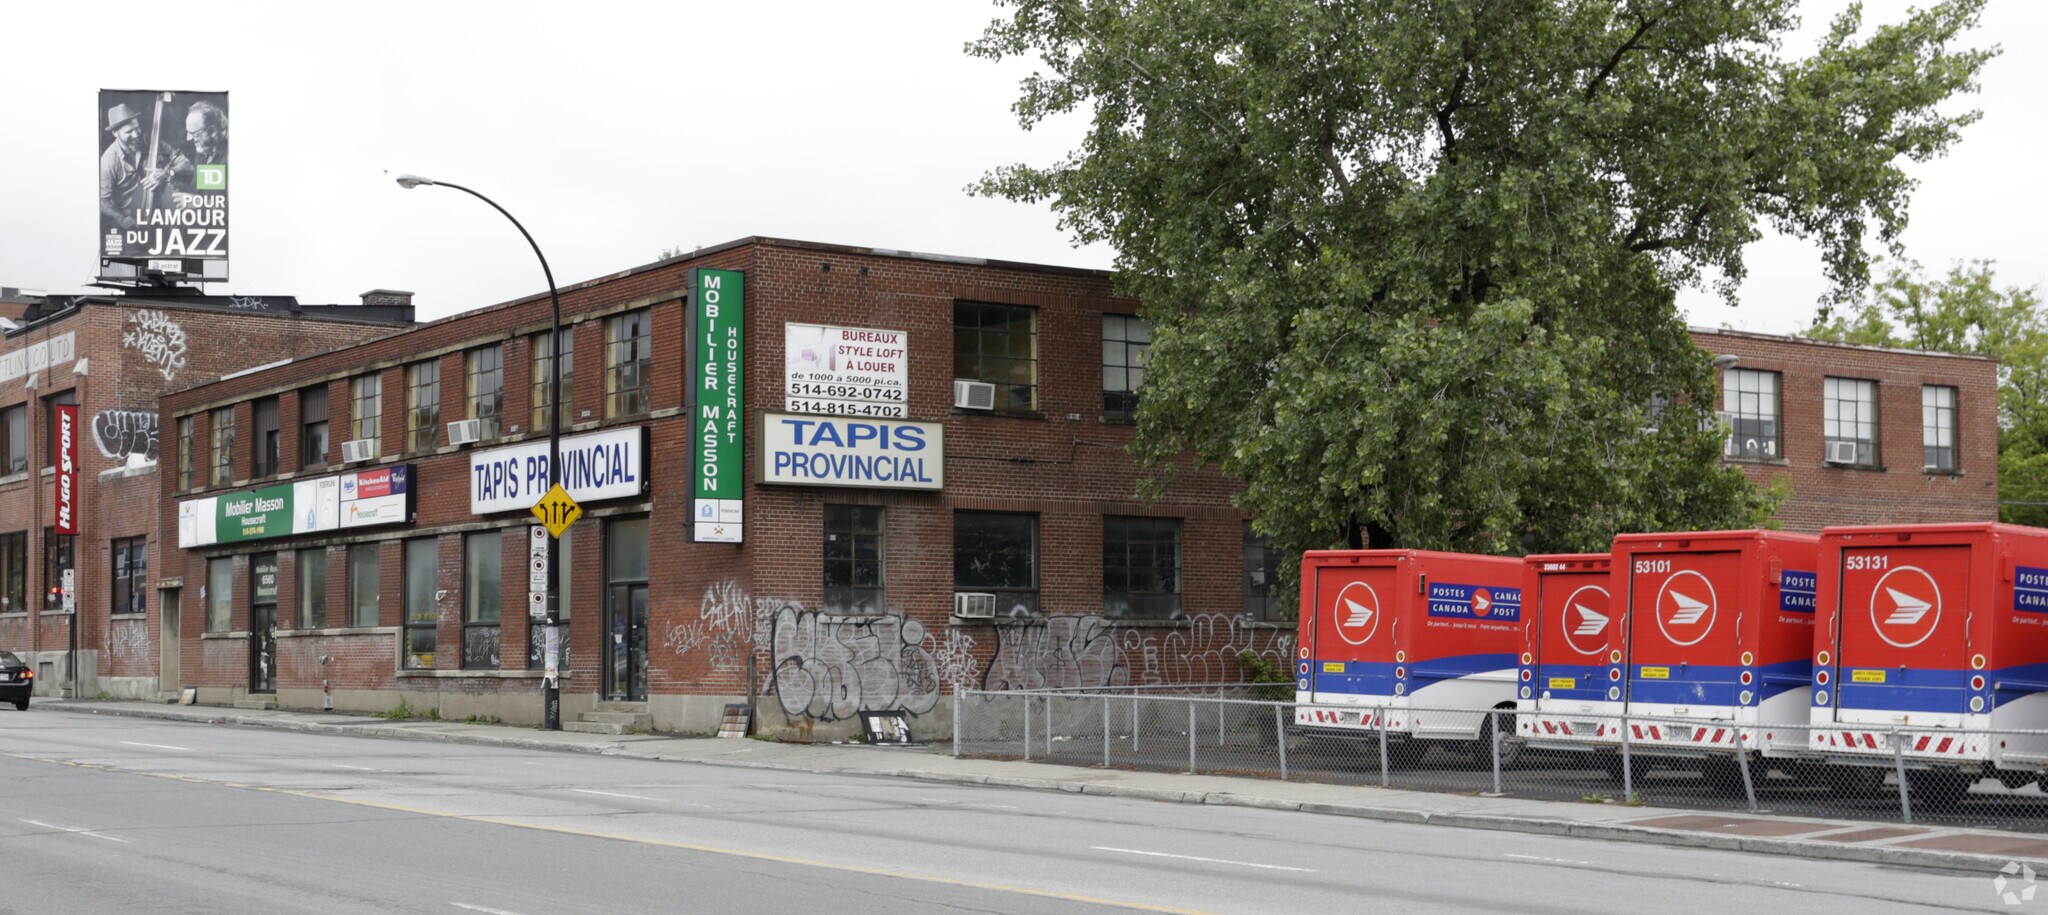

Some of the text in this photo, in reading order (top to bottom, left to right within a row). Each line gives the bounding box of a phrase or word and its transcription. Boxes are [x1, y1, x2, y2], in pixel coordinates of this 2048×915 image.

[200, 169, 223, 185] TD
[183, 195, 225, 209] POUR
[136, 209, 226, 227] L'AMOUR
[127, 231, 149, 244] DU
[148, 228, 226, 256] JAZZ
[842, 330, 898, 345] BUREAUX
[50, 338, 70, 361] LTD
[838, 345, 904, 359] STYLE LOFT
[857, 361, 896, 373] LOUER
[702, 275, 721, 491] MOBILIER MASSON
[727, 326, 737, 443] HOUSECRAFT
[791, 371, 805, 380] de
[808, 373, 834, 382] 1000
[846, 376, 872, 385] 5000
[791, 383, 902, 401] 514-692-0742
[791, 400, 902, 418] 514-815-4702
[781, 419, 926, 452] TAPIS
[59, 410, 73, 530] HUGO SPORT
[474, 442, 635, 502] TAPIS PRVINCIAL
[774, 451, 933, 483] PROVINCIAL
[225, 497, 284, 517] Mobilier Masson
[241, 514, 267, 526] Housecraft
[1635, 559, 1671, 574] 53101
[1846, 554, 1889, 570] 53131
[1785, 575, 1815, 588] POSTE
[2019, 573, 2048, 587] POSTE
[1433, 587, 1521, 602] POSTES CANAD
[1785, 595, 1816, 608] CANAD
[2019, 594, 2048, 607] CANA
[1432, 603, 1515, 617] CANADA POST
